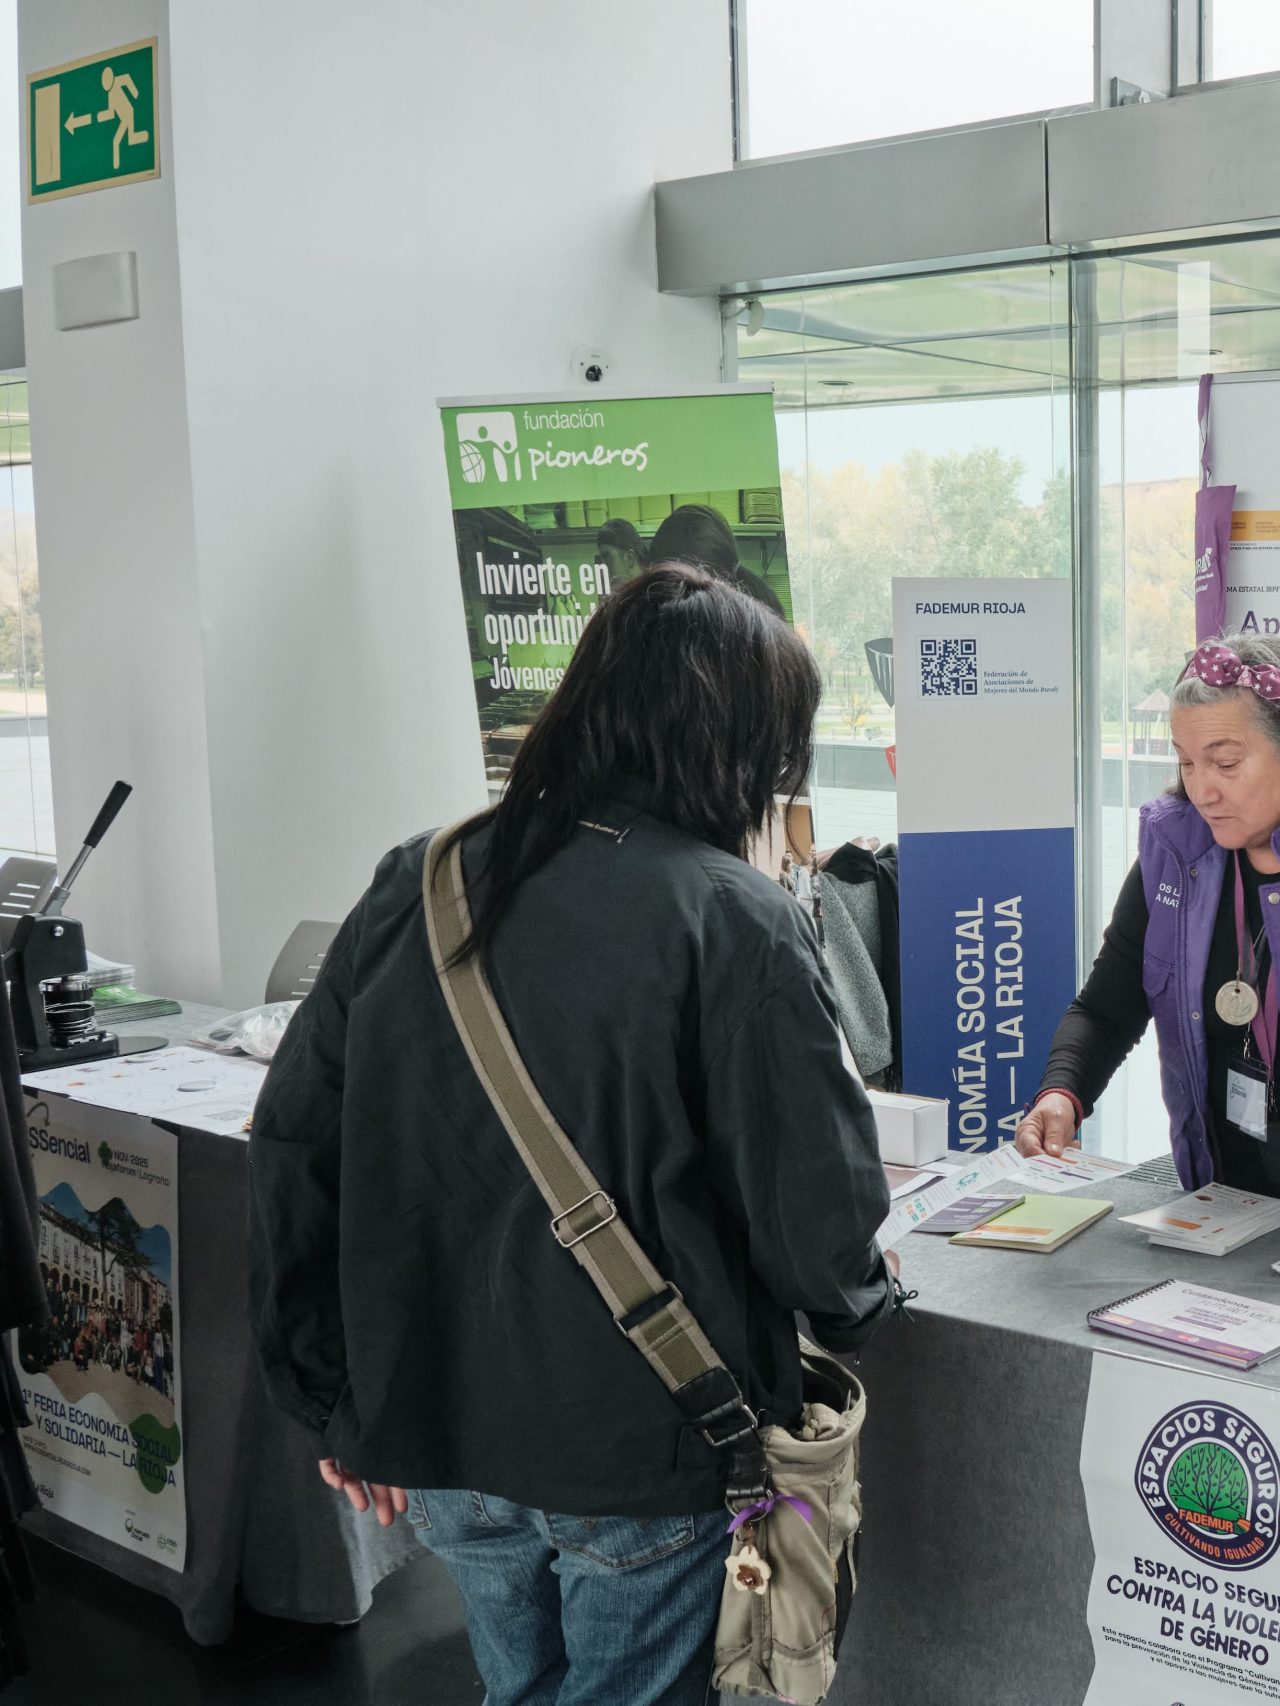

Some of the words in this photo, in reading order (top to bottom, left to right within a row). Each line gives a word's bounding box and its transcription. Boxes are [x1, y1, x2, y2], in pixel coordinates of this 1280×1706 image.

[523, 408, 604, 430] fundación
[527, 440, 649, 481] pioneros
[476, 551, 572, 595] Invierte
[579, 562, 611, 595] en
[484, 602, 597, 655] oportuni
[916, 603, 980, 614] FADEMUR
[983, 603, 1026, 614] RIOJA
[490, 656, 564, 690] Jóvenes
[955, 897, 985, 1033] SOCIAL
[994, 896, 1024, 1007] RIOJA
[996, 1014, 1024, 1059] LA
[952, 1040, 987, 1154] NOMÍA
[34, 1393, 67, 1421] FERIA
[69, 1406, 130, 1446] ECONOMÍA
[132, 1431, 174, 1461] SOCIAL
[35, 1414, 43, 1430] Y
[45, 1418, 107, 1458] SOLIDARIA
[123, 1449, 138, 1471] LA
[140, 1457, 177, 1488] RIOJA
[1141, 1409, 1216, 1509] ESPACIOS
[1223, 1416, 1275, 1539] SEGUROS
[1164, 1512, 1222, 1559] CULTIVANDO
[1224, 1536, 1265, 1561] IGUALDAD
[1177, 1508, 1234, 1533] FADEMUR
[1106, 1574, 1186, 1615] CONTRA
[1192, 1598, 1216, 1624] LA
[1133, 1556, 1218, 1595] ESPACIO
[1102, 1625, 1117, 1636] Este
[1118, 1630, 1147, 1645] espacio
[1148, 1639, 1181, 1655] colabora
[1182, 1649, 1197, 1660] con
[1198, 1653, 1206, 1663] el
[1206, 1657, 1243, 1676] Programa
[1105, 1635, 1122, 1647] para
[1131, 1642, 1171, 1662] prevención
[1172, 1653, 1181, 1663] de
[1191, 1659, 1226, 1677] Violencia
[1227, 1671, 1237, 1680] de
[1239, 1674, 1267, 1690] Género
[1269, 1684, 1278, 1693] en
[1160, 1616, 1184, 1643] DE
[1189, 1623, 1269, 1667] GÉNERO
